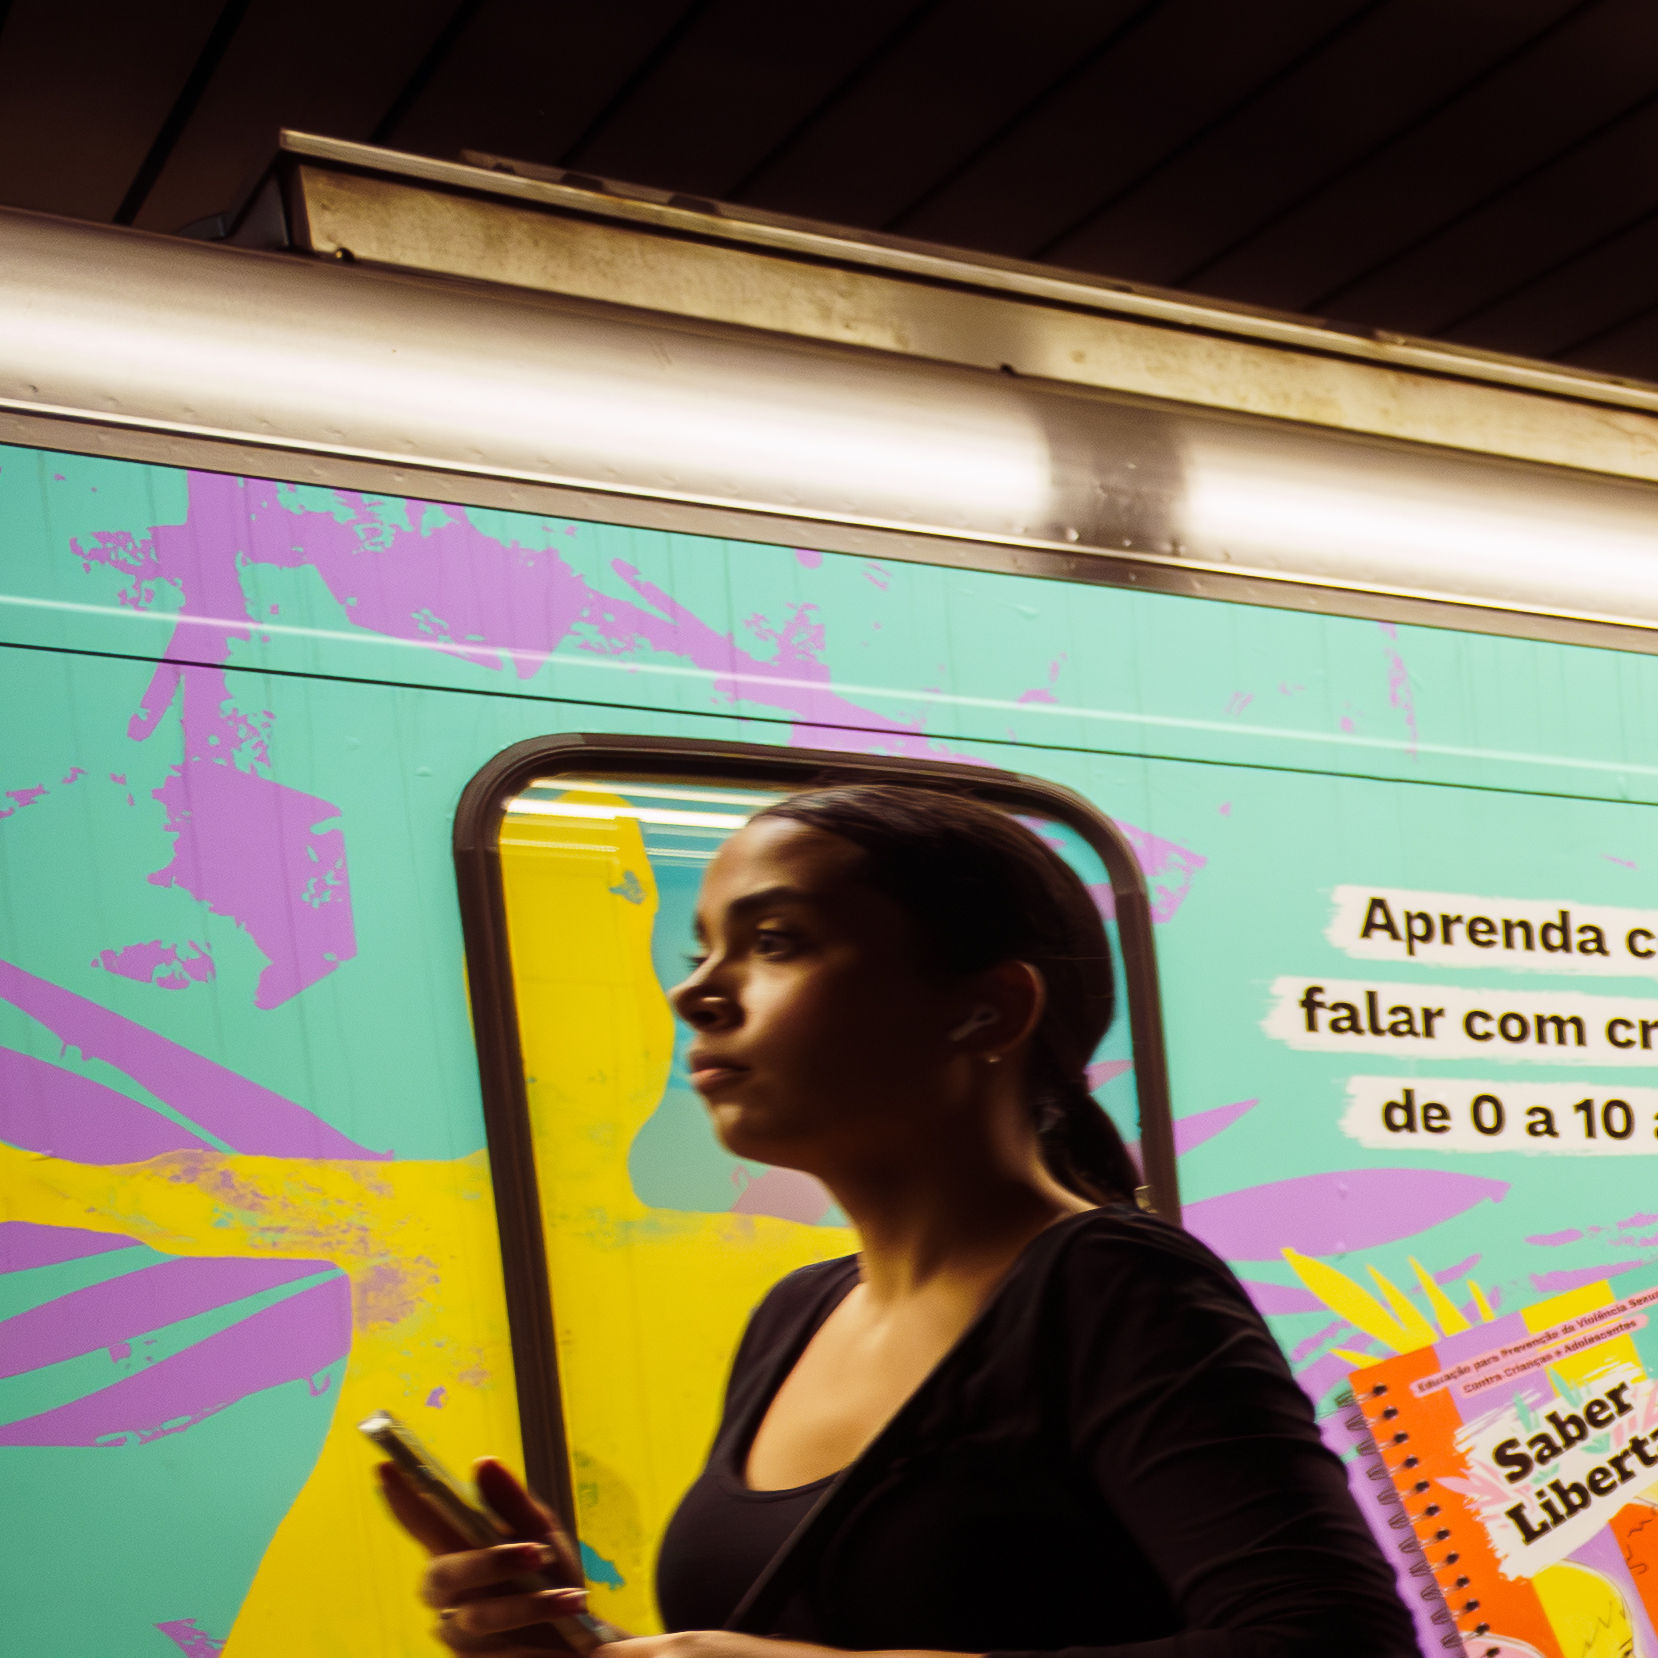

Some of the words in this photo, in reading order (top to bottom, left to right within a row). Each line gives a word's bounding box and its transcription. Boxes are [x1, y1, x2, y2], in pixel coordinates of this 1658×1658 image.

[1359, 896, 1609, 955] Aprenda
[1300, 986, 1445, 1038] falar
[1463, 1007, 1587, 1047] com
[1382, 1088, 1451, 1134] de
[1470, 1094, 1504, 1136] 0
[1525, 1106, 1557, 1138] a
[1573, 1099, 1634, 1141] 10
[1418, 1366, 1471, 1393] Educação
[1474, 1354, 1499, 1371] para
[1501, 1331, 1559, 1359] Prevenção
[1577, 1304, 1627, 1328] Violência
[1463, 1373, 1502, 1393] Contra
[1505, 1354, 1554, 1377] Crianças
[1564, 1320, 1636, 1354] Adolescentes
[1493, 1381, 1634, 1484] Saber
